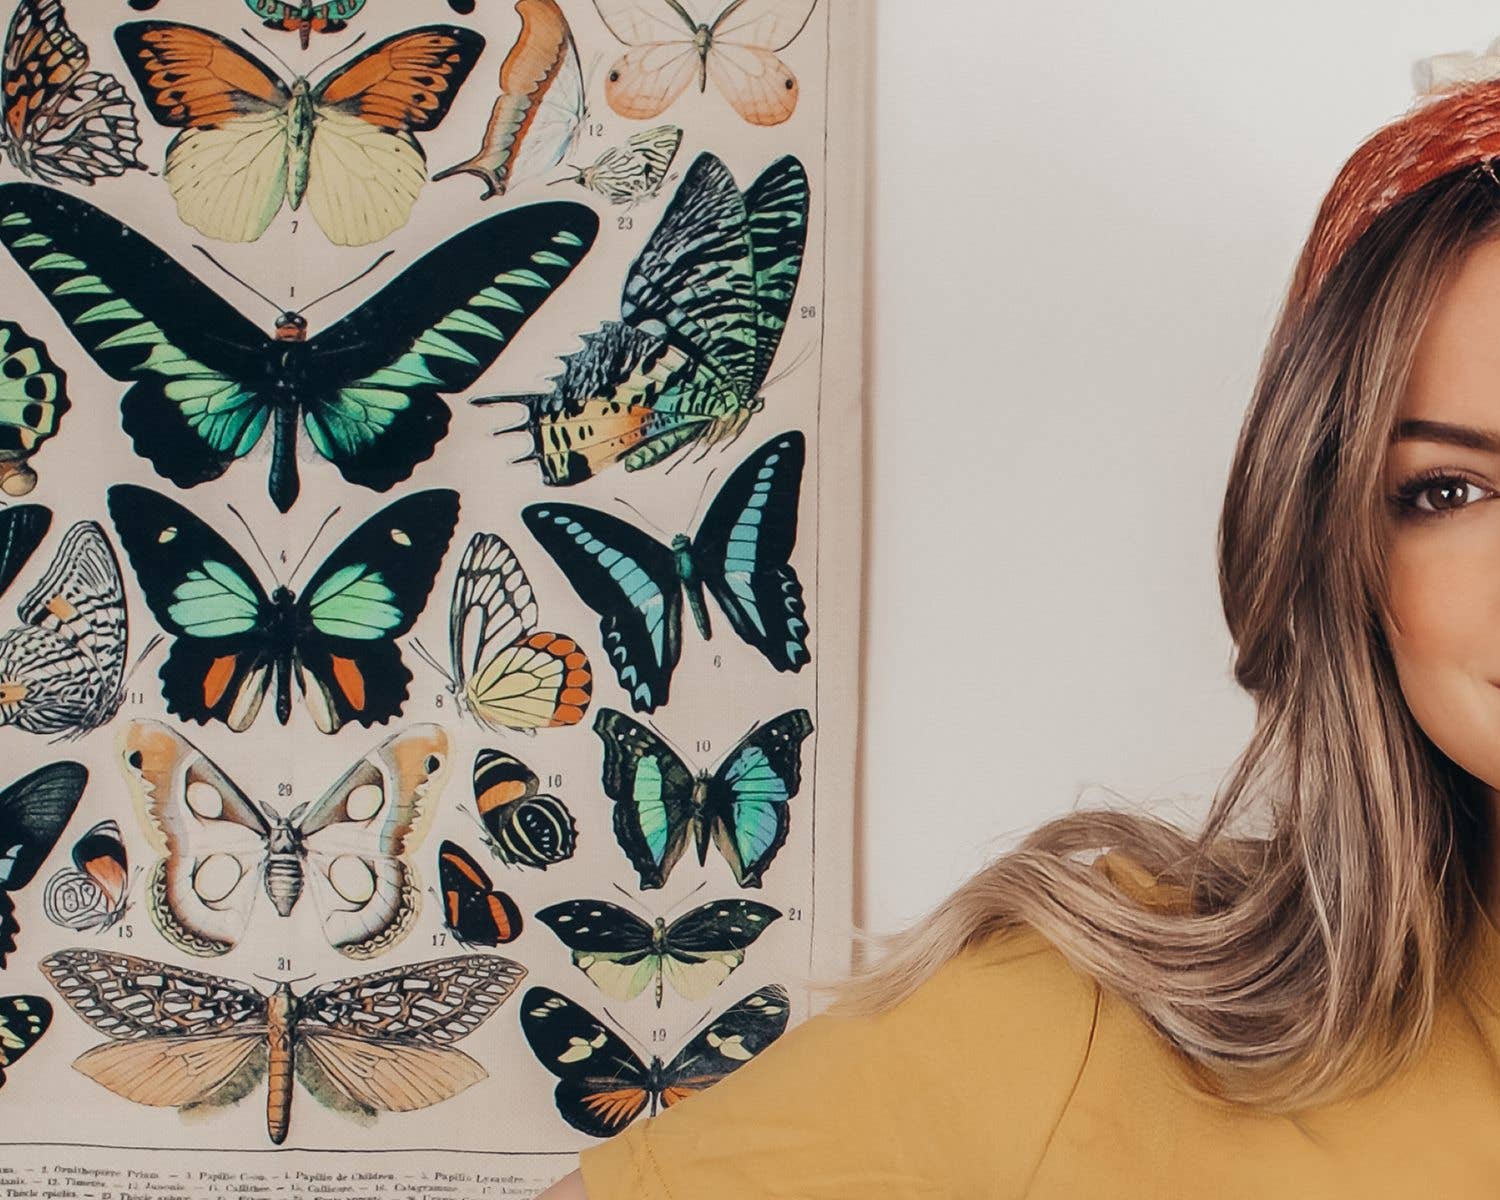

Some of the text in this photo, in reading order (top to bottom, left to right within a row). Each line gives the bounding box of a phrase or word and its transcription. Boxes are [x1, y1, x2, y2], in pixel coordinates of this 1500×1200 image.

[589, 124, 604, 137] 12
[290, 220, 300, 234] 7
[617, 216, 633, 230] 23
[800, 306, 816, 319] 26
[713, 655, 722, 668] 6
[435, 694, 444, 708] 8
[696, 740, 711, 753] 10
[788, 907, 802, 921] 21
[117, 925, 134, 939] 15
[432, 932, 446, 947] 17
[652, 1028, 667, 1042] 19
